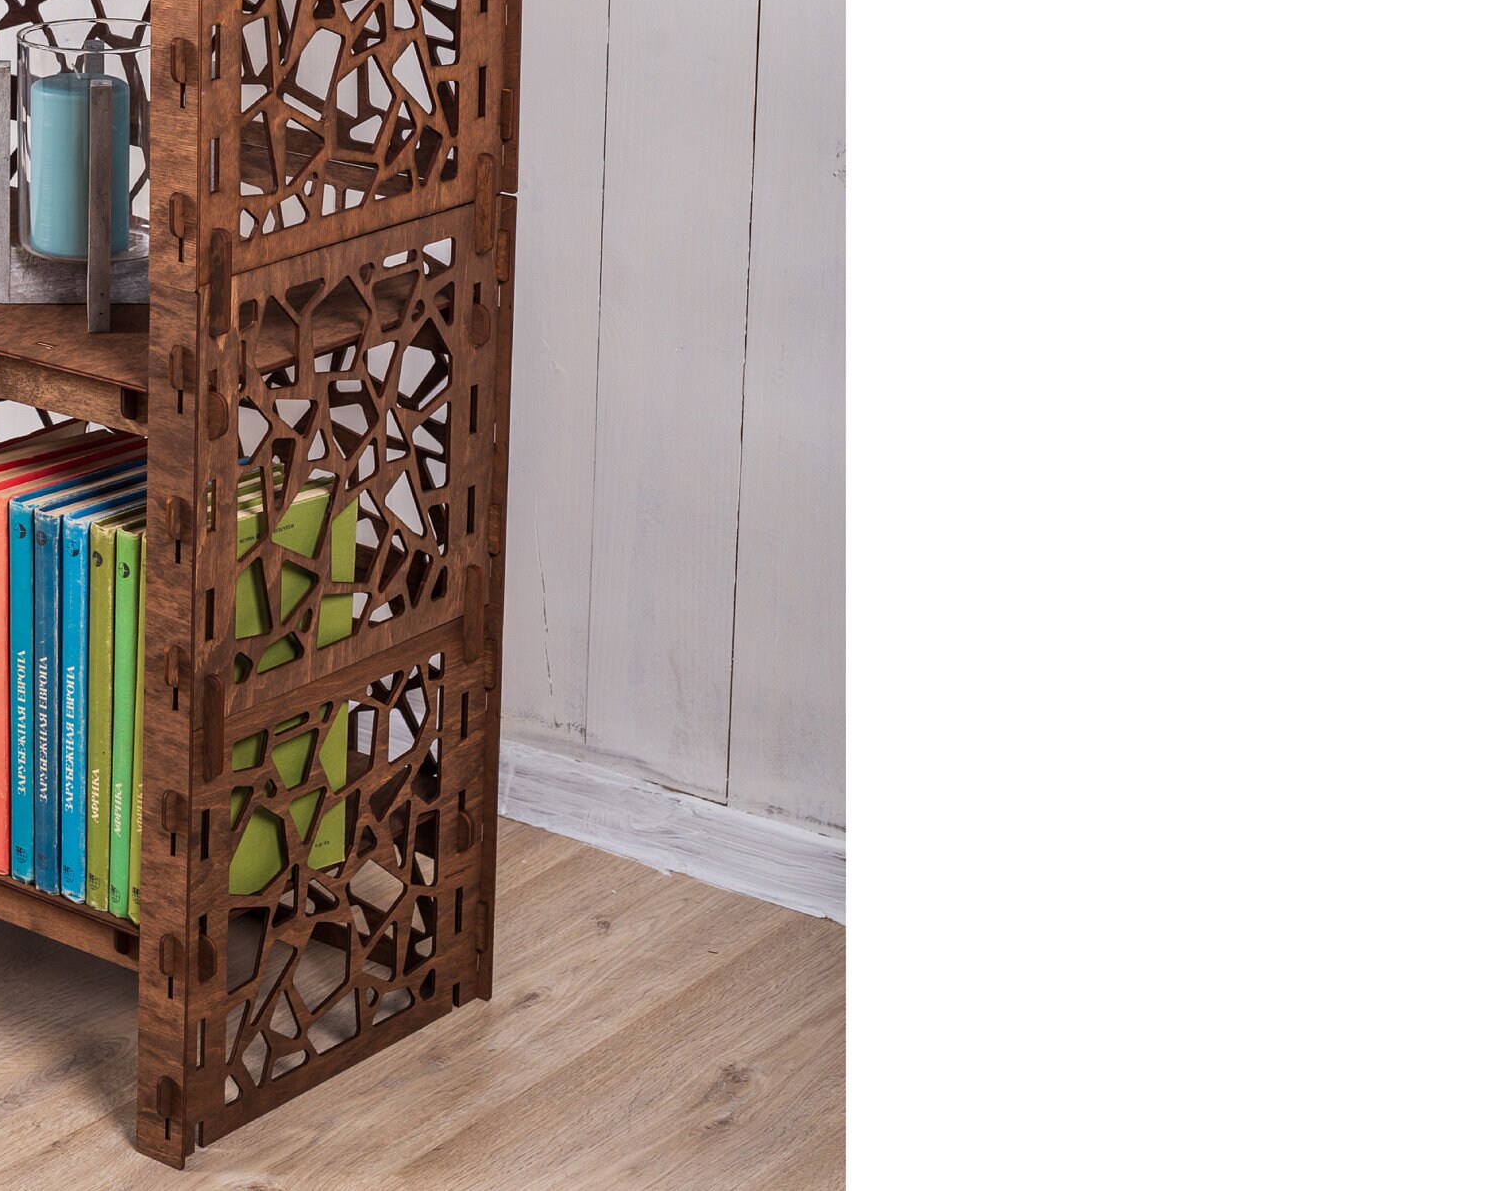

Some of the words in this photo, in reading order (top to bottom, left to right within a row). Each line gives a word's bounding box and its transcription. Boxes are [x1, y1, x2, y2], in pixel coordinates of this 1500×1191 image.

[17, 650, 26, 703] ЕВРОПА
[39, 656, 48, 710] ЕВРОПА
[66, 665, 76, 719] ЕВРОПА
[17, 707, 27, 797] ЗАРУБЕЖНАЯ
[39, 712, 48, 804] ЗАРУБЕЖНАЯ
[65, 721, 75, 813] ЗАРУБЕЖНАЯ
[91, 768, 100, 824] АФРИКА
[113, 782, 123, 837] АФРИКА
